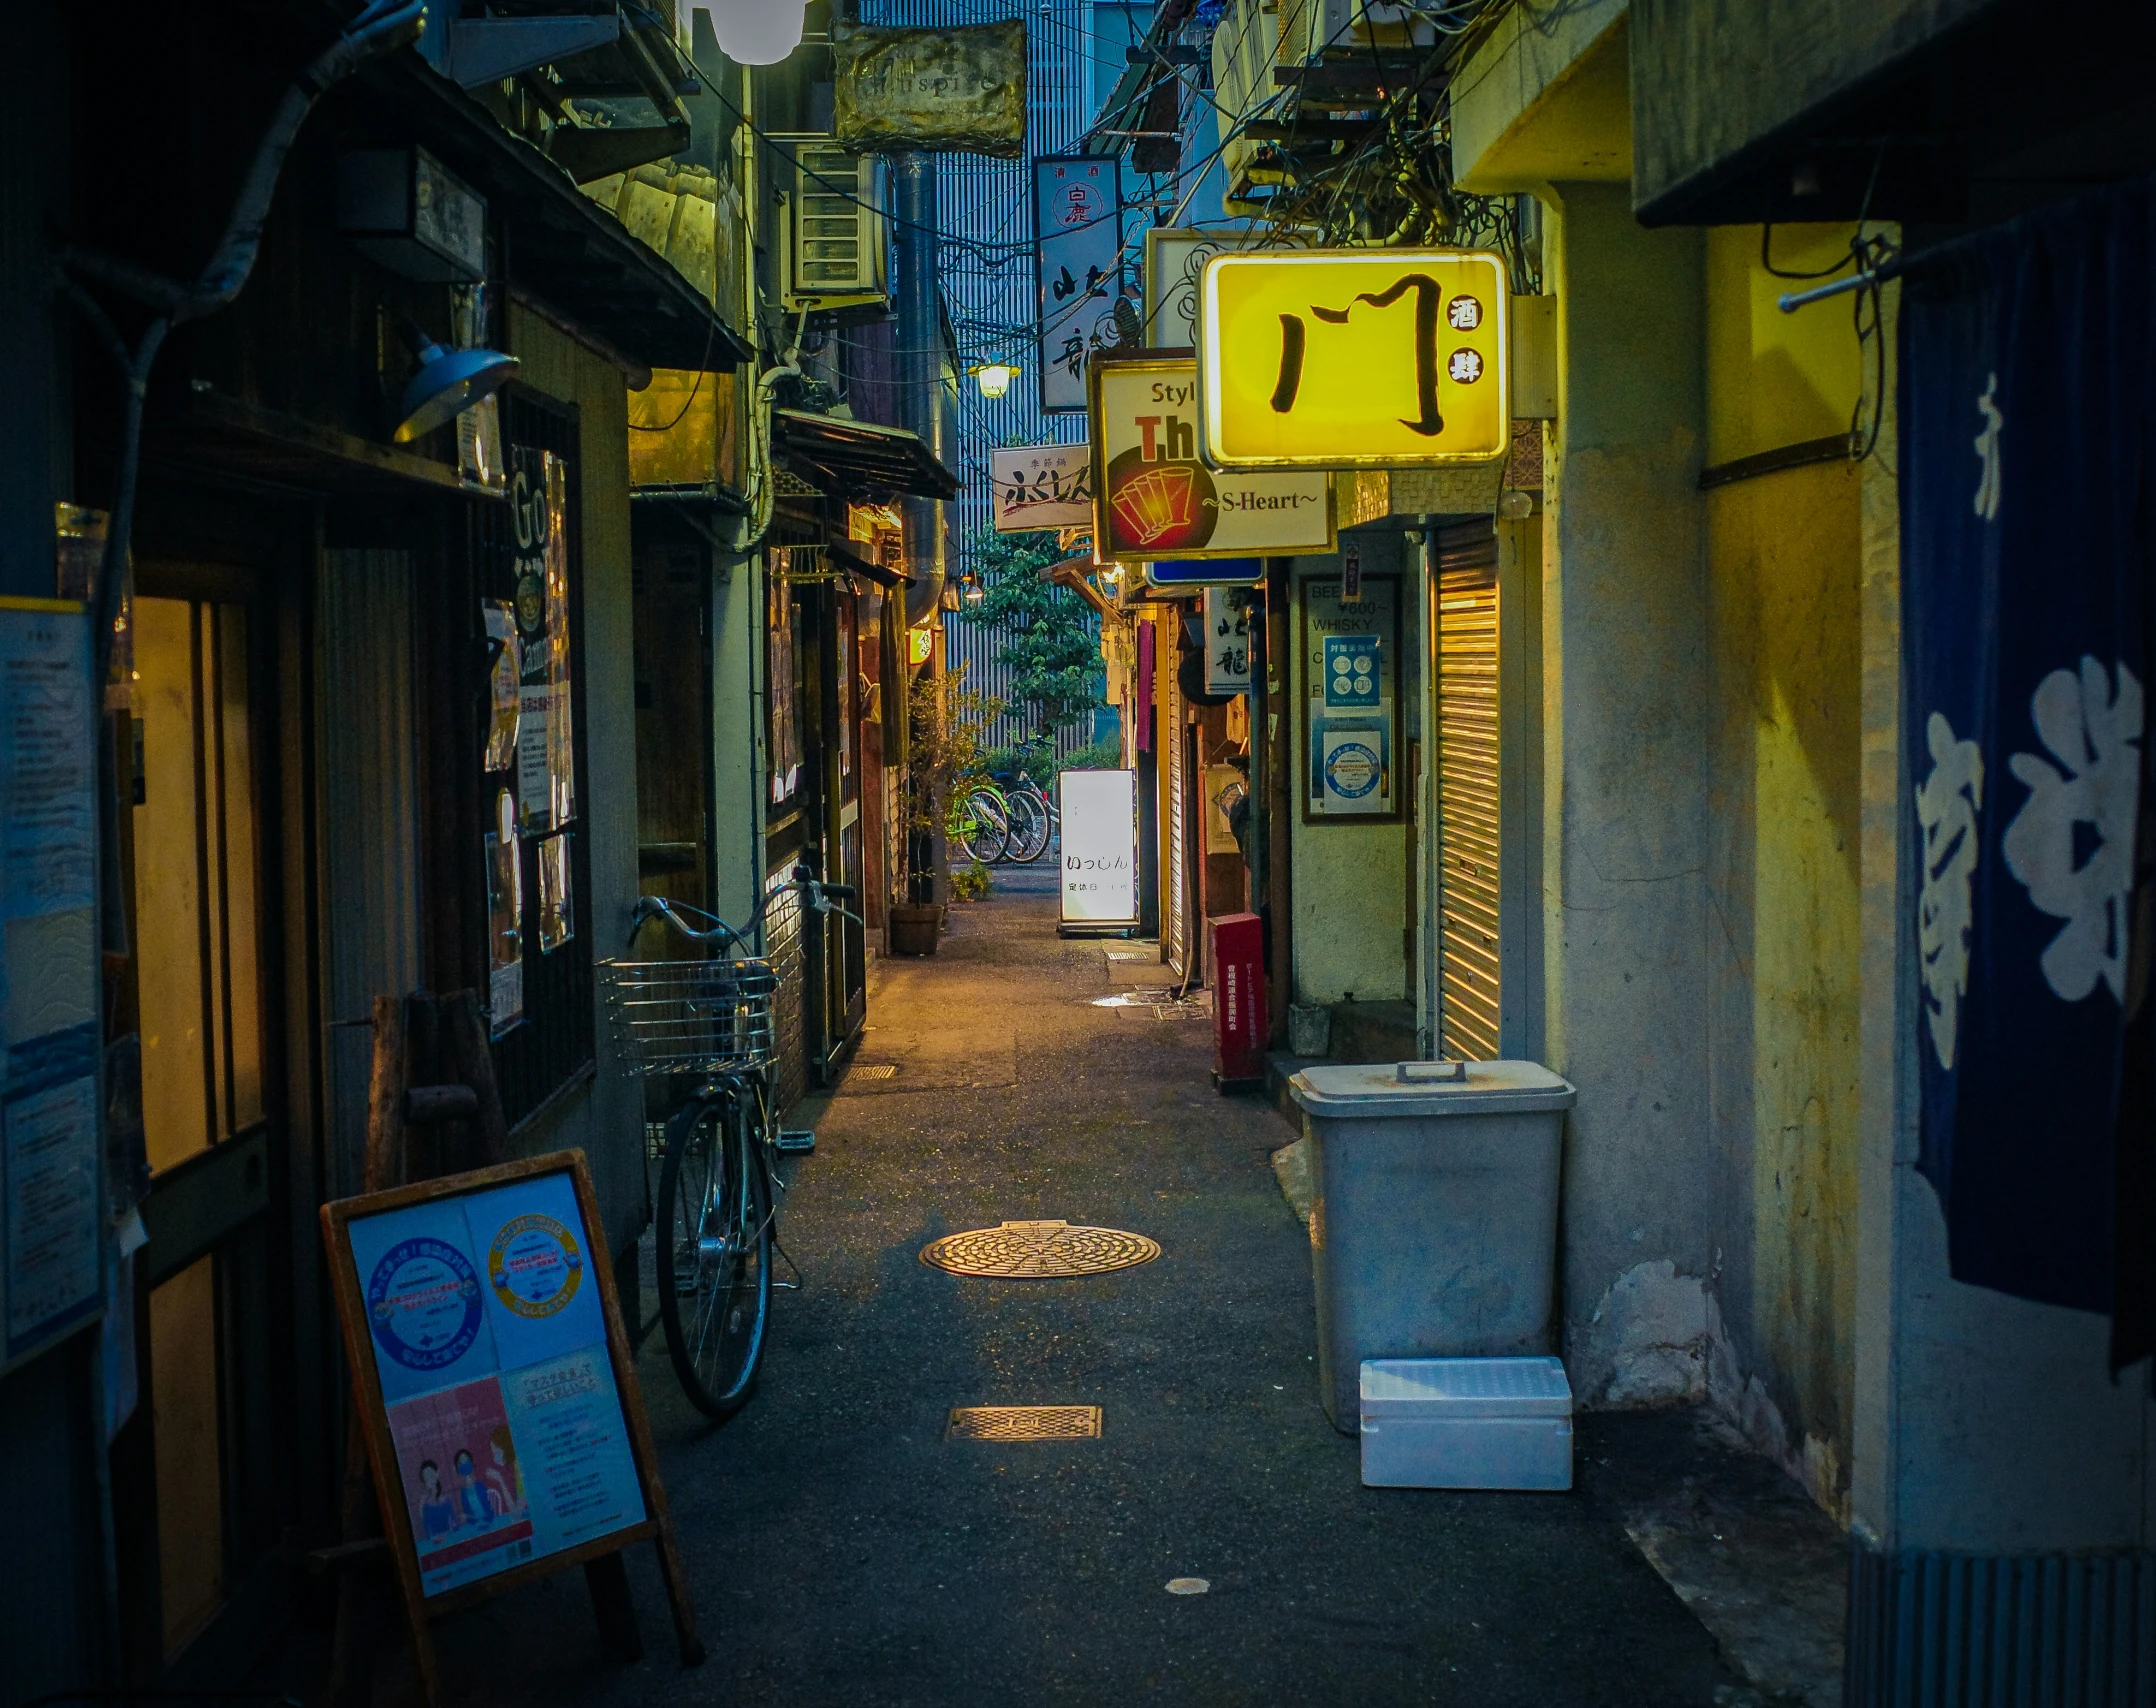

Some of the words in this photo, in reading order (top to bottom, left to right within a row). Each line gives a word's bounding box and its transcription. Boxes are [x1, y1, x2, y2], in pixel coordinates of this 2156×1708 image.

[1151, 381, 1195, 406] Styl
[1134, 415, 1196, 463] Th
[1311, 586, 1341, 599] BEE
[1313, 619, 1373, 631] WHISKY
